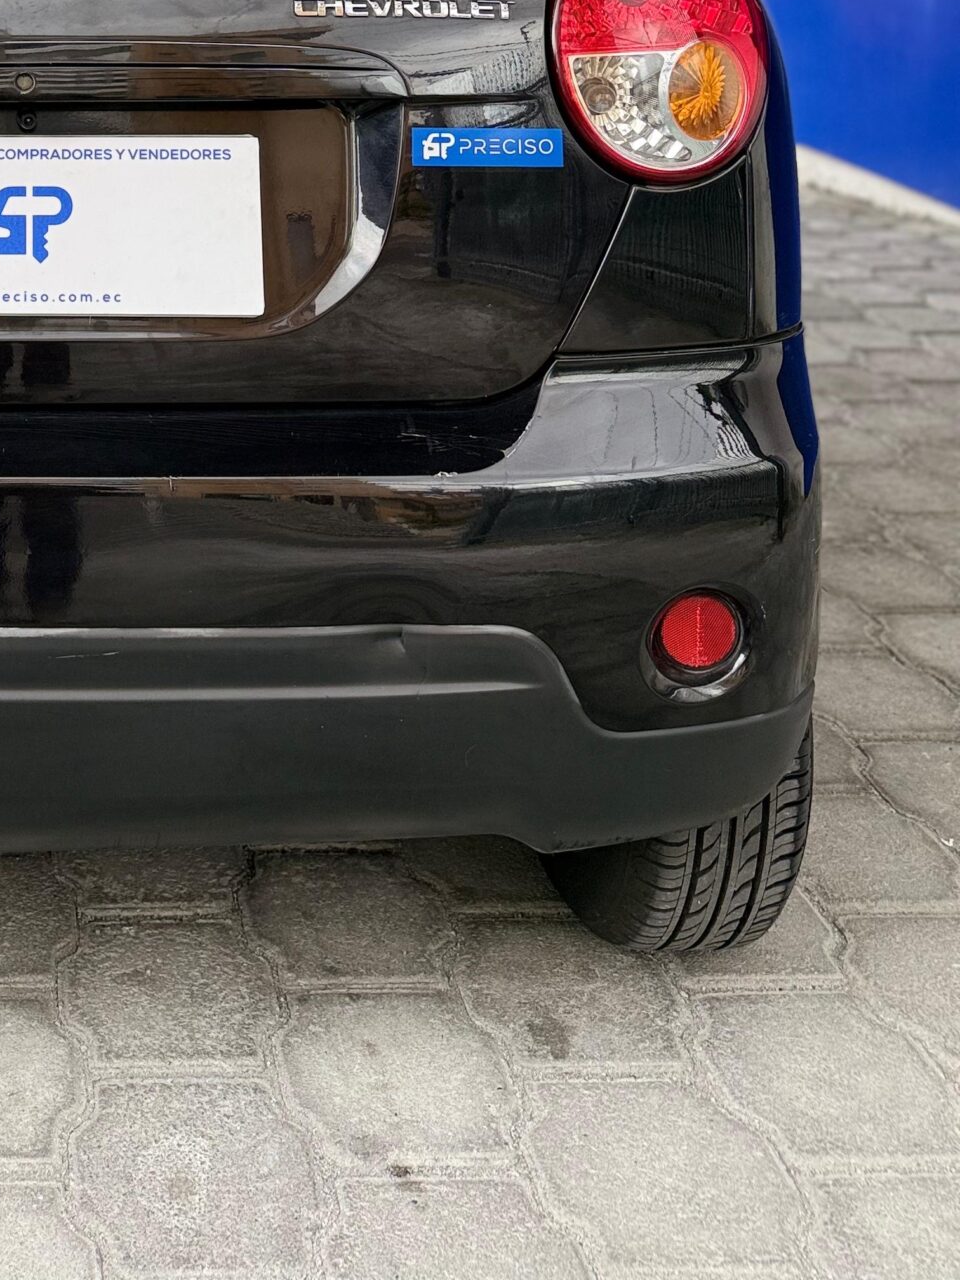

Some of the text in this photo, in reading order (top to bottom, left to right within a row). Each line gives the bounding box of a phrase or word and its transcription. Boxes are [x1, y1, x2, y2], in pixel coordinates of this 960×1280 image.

[459, 138, 554, 155] PRECISO
[115, 148, 125, 160] Y
[128, 148, 231, 160] VENDEDORES
